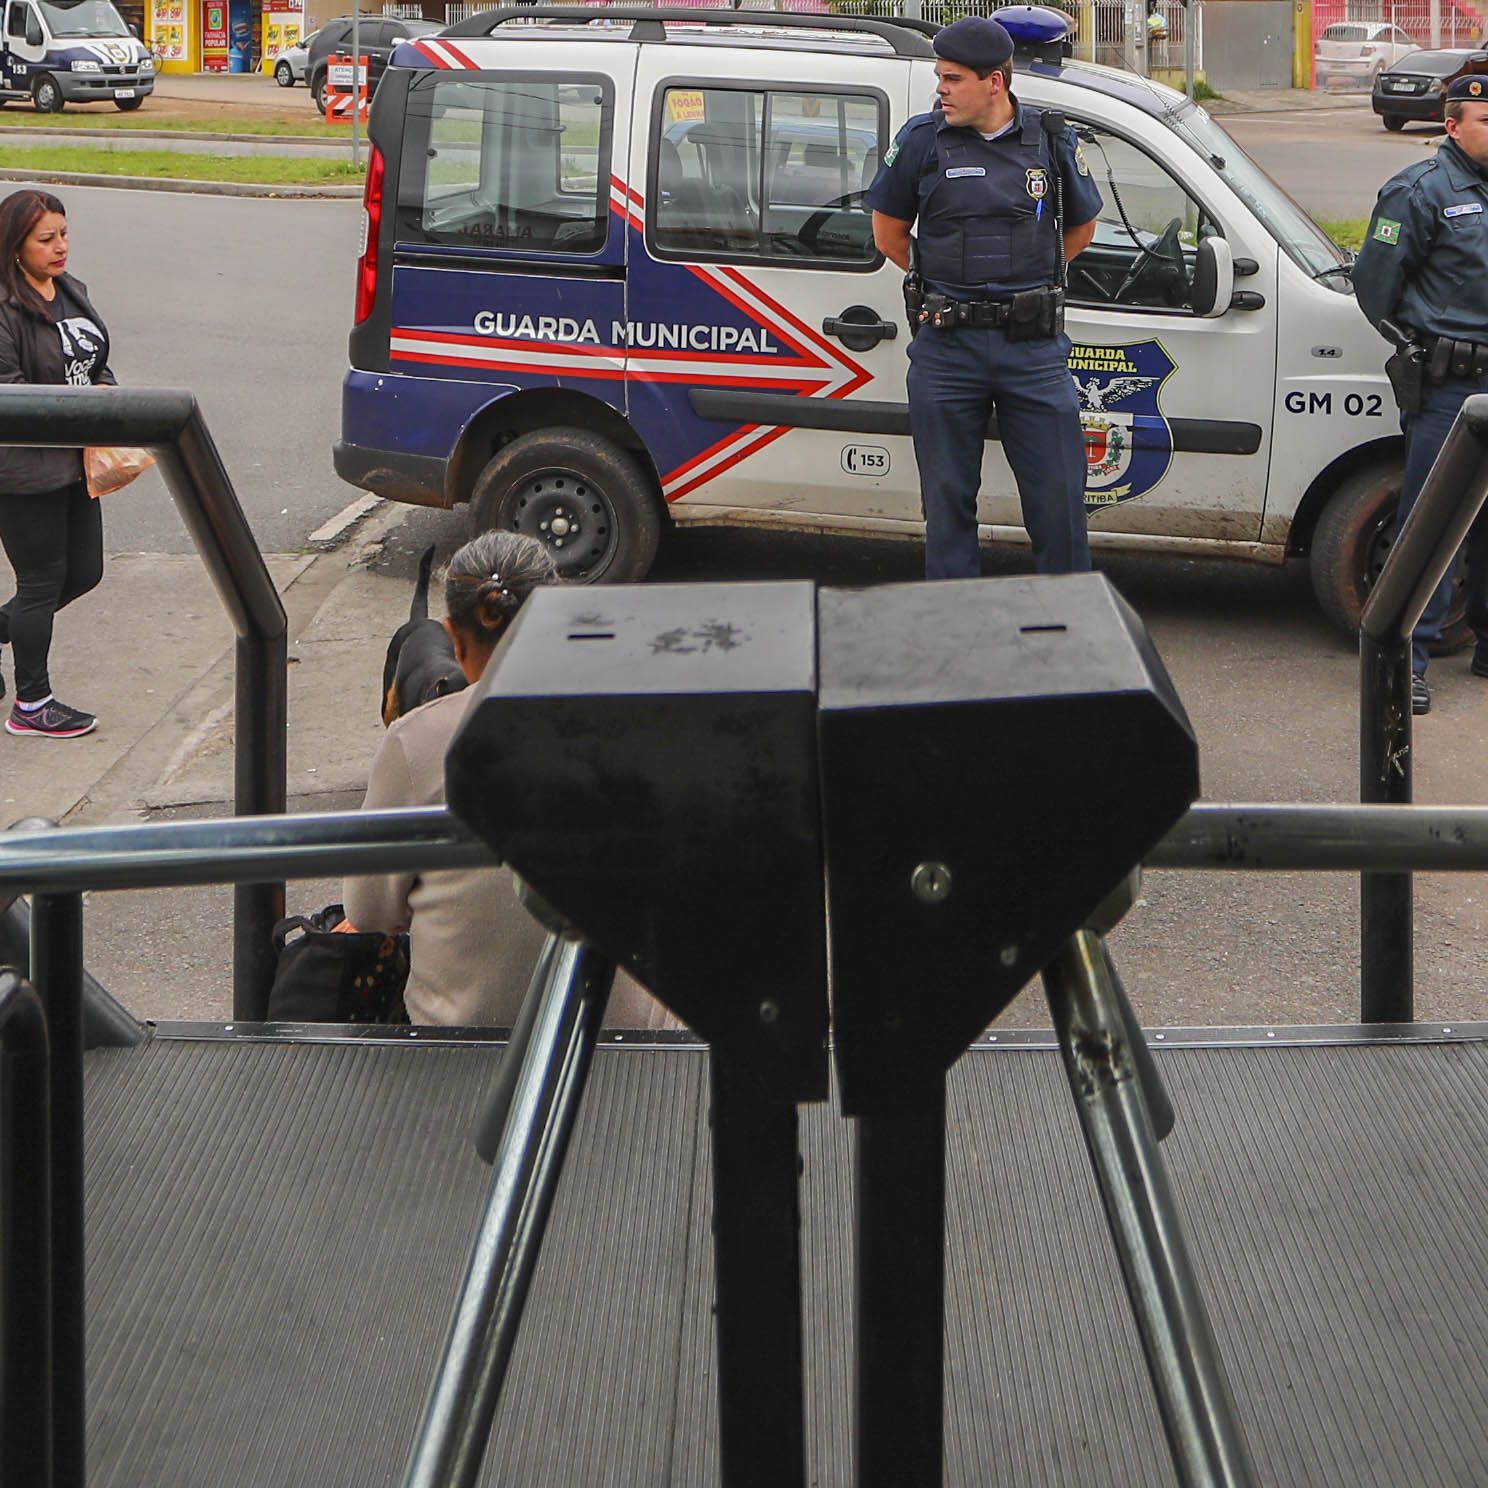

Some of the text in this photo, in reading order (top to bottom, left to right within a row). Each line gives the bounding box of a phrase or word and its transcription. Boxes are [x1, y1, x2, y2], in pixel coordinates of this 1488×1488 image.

[474, 310, 778, 355] GUARDA MUNICIPAL
[1067, 359, 1138, 373] UNICIPAL
[1284, 391, 1383, 417] GM 02
[860, 452, 885, 468] 153
